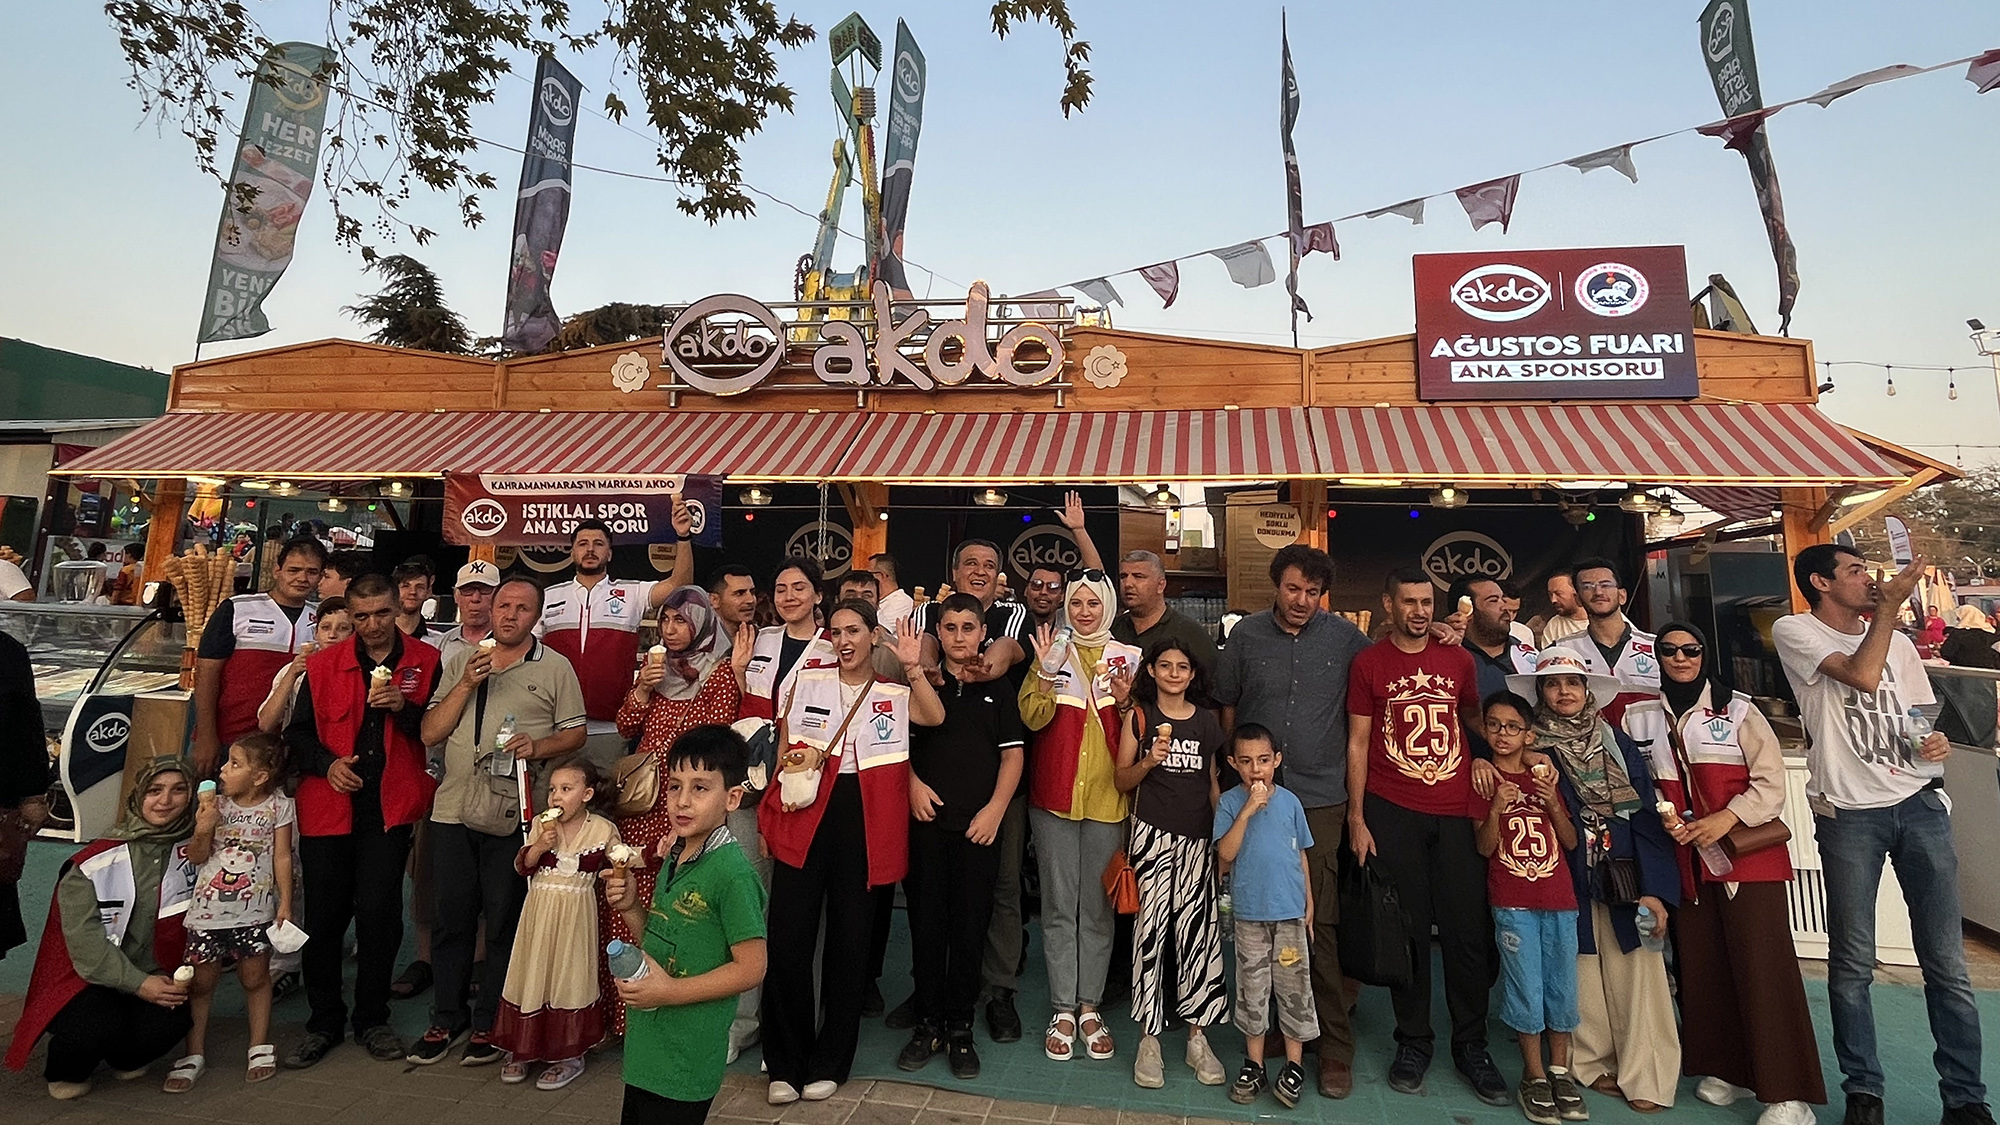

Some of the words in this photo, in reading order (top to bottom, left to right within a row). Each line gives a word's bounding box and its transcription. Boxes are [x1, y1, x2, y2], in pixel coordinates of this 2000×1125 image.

[261, 111, 316, 149] HER
[1460, 277, 1539, 303] akdo
[678, 319, 769, 359] akdo
[813, 279, 1067, 391] akdo
[1430, 334, 1582, 358] AĞUSTOS
[1589, 333, 1685, 355] FUARI
[1458, 363, 1514, 379] ANA
[1520, 362, 1658, 378] SPONSORU
[598, 480, 643, 488] MARKASI
[645, 480, 675, 489] AKDO
[465, 507, 502, 525] akdo
[597, 502, 647, 518] SPOR
[522, 520, 558, 534] ANA
[561, 519, 649, 534] SPSORU
[1257, 528, 1296, 537] DONDURMA
[1016, 537, 1078, 562] akdo
[1430, 546, 1501, 576] akdo
[90, 721, 128, 741] akdo
[1403, 704, 1450, 756] 25
[1508, 816, 1548, 857] 25
